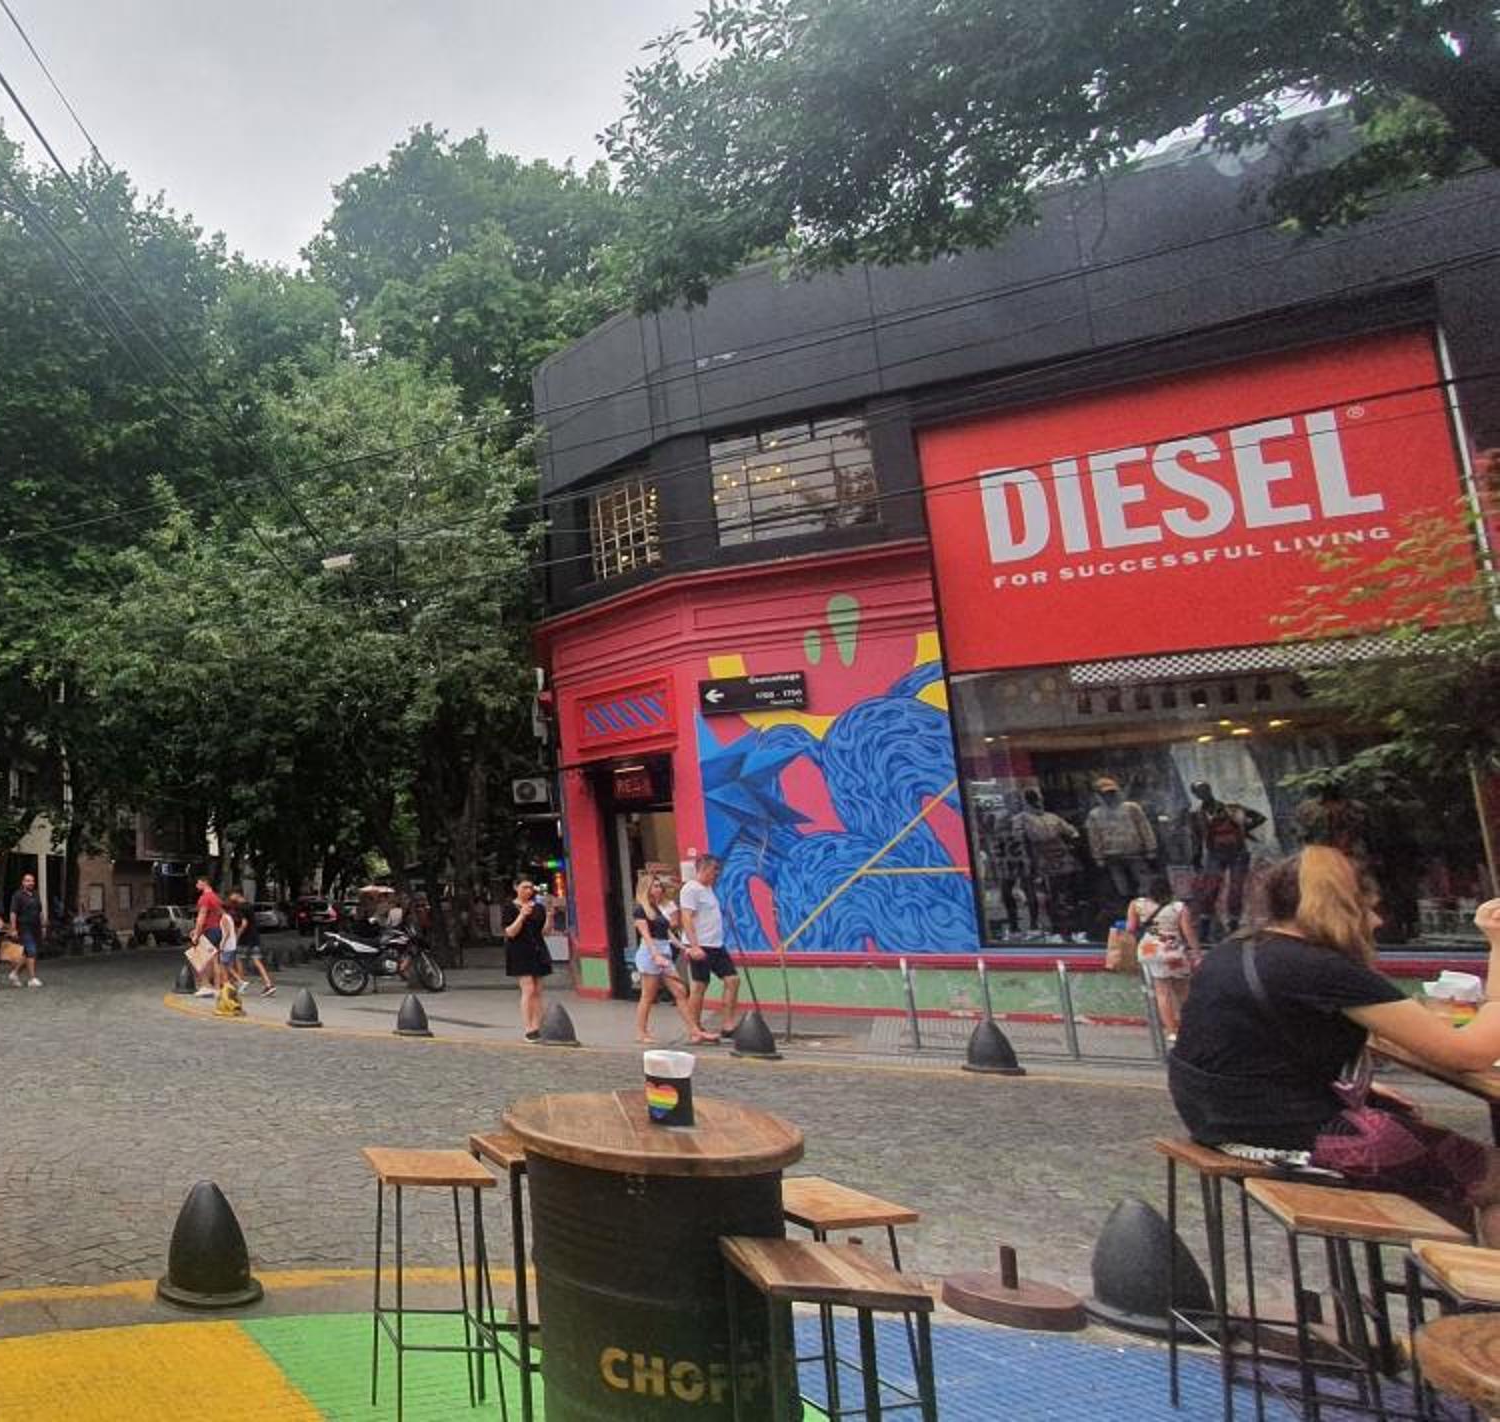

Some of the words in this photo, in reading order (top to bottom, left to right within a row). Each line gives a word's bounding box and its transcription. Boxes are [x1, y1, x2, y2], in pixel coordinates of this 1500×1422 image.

[979, 409, 1385, 564] DIESEL
[993, 570, 1049, 589] FOR
[1058, 543, 1263, 581] SUCCESSFUL
[1273, 526, 1392, 555] LIVING
